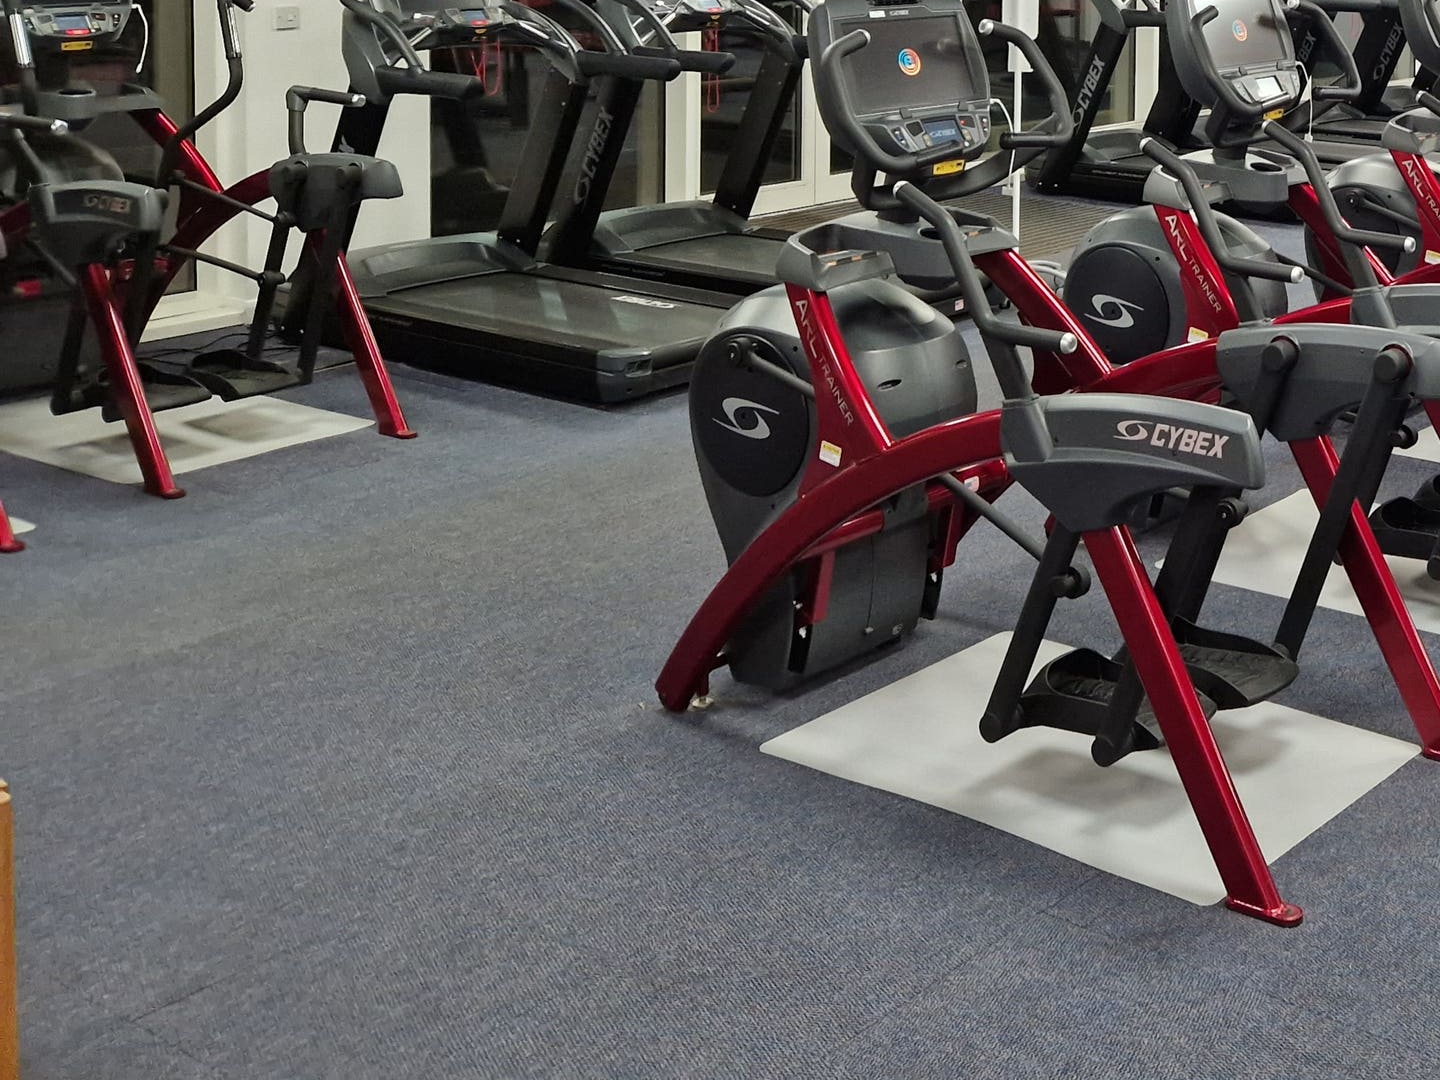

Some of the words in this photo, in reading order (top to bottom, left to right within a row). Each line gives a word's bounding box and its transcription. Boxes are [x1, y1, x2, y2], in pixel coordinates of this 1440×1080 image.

[1076, 53, 1106, 107] CYBEX
[1188, 255, 1222, 314] TRAINER
[818, 356, 855, 425] TRAINER
[1149, 422, 1230, 459] CYBEX
